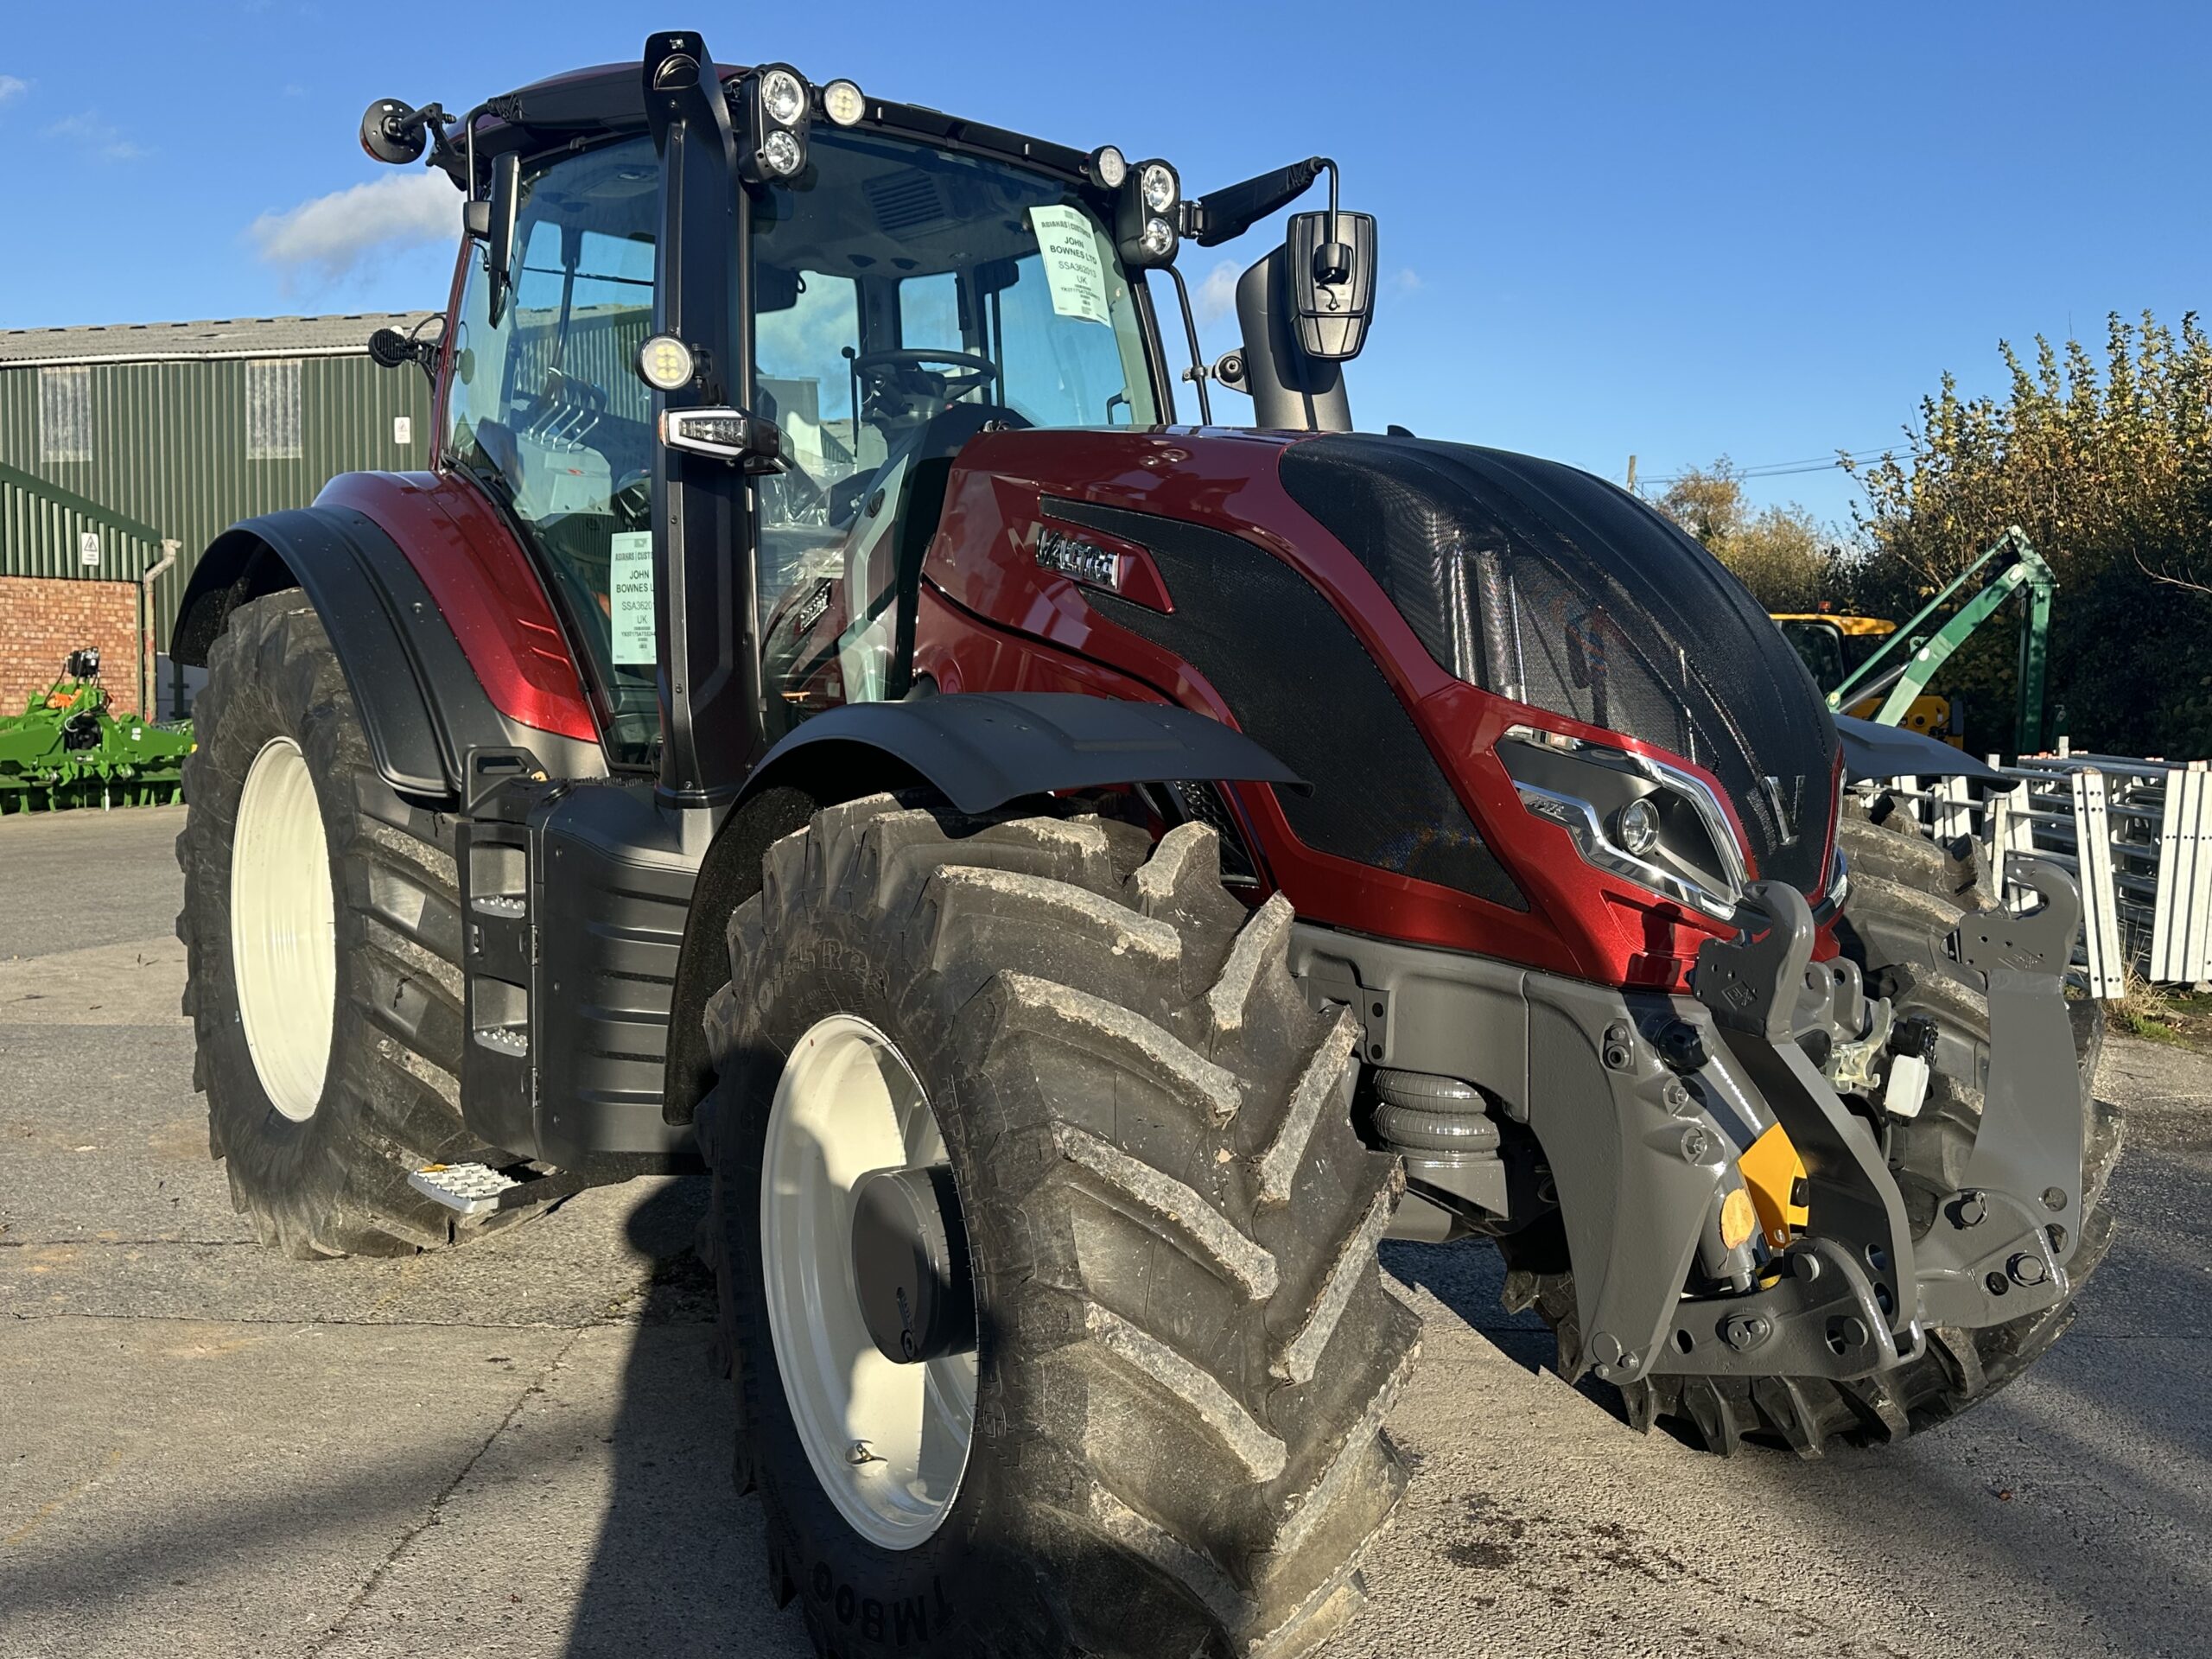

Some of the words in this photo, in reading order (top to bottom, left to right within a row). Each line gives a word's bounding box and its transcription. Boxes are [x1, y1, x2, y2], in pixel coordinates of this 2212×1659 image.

[1064, 237, 1084, 249] JOHN
[1049, 245, 1085, 259] BOWNES
[1085, 252, 1097, 265] LTD
[1076, 275, 1088, 285] UK
[629, 569, 650, 580] JOHN
[615, 583, 649, 594] BOWNES
[621, 601, 653, 612] SSA3620
[637, 614, 648, 625] UK
